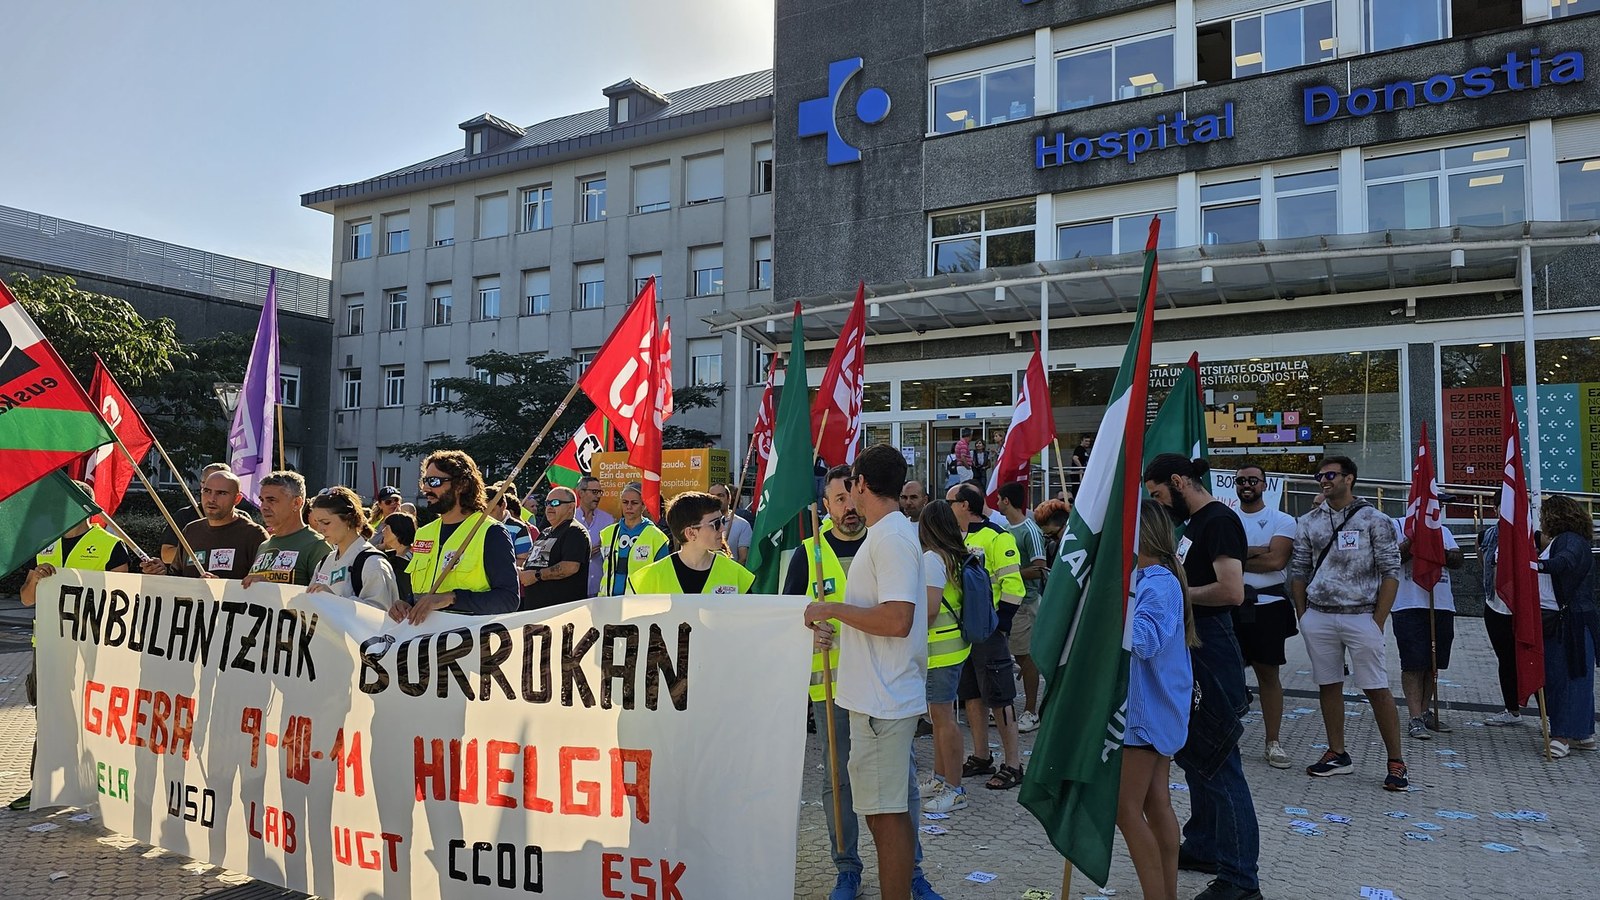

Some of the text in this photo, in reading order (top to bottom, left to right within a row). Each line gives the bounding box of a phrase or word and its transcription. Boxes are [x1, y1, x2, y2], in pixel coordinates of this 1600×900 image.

[1035, 47, 1586, 170] Hospital Donostia
[1248, 360, 1309, 374] OSPITALEA
[1251, 371, 1309, 383] DONOSTIA
[1450, 392, 1500, 403] EZ ERRE
[1451, 410, 1500, 420] EZ ERRE
[1451, 427, 1501, 437] EZ ERRE
[1452, 444, 1502, 454] EZ ERRE
[662, 460, 687, 469] zaude.
[1453, 461, 1504, 471] EZ ERRE
[600, 470, 614, 478] Ezin
[615, 470, 625, 478] da
[59, 584, 319, 682] ANBULANTZIAK
[83, 680, 653, 825] GREBA 9-10-11 HUELGA
[97, 761, 687, 900] ELA USO LAB UGT CCOO ESK
